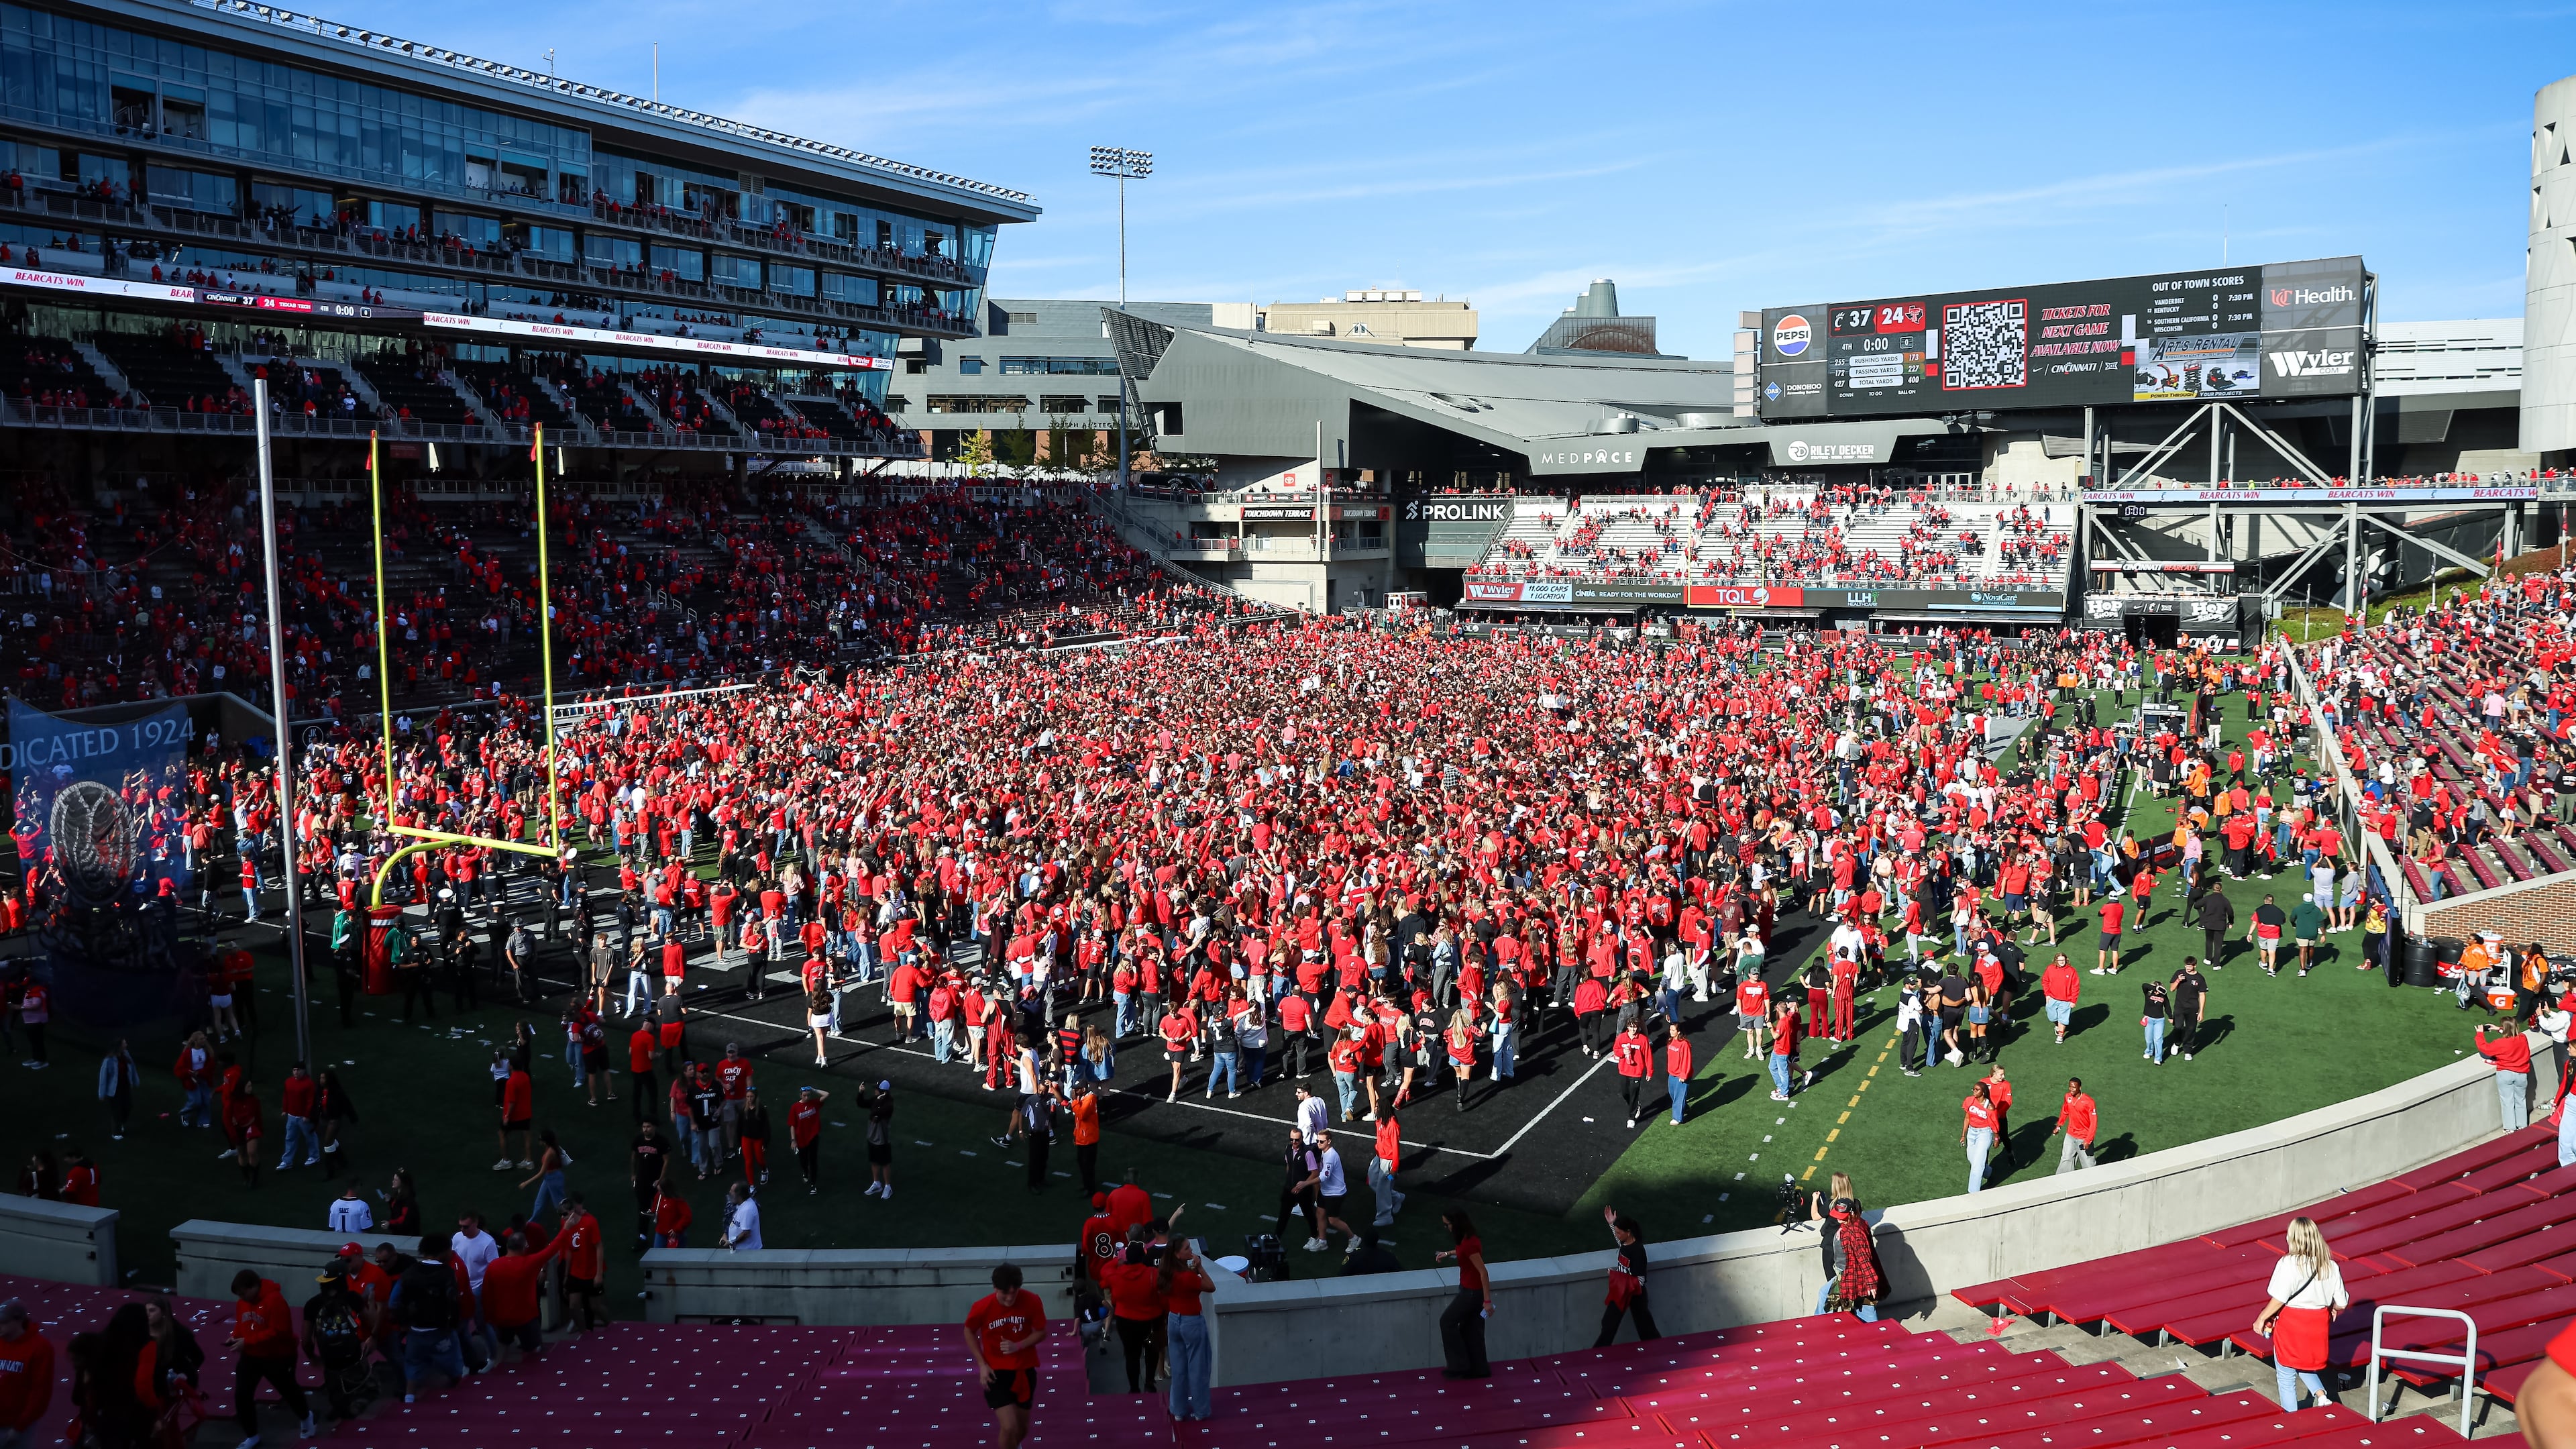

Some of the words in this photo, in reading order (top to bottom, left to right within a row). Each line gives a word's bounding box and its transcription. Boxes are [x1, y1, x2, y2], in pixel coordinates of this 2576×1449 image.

[15, 272, 64, 285] BEARCATS
[66, 278, 85, 287] WIN
[2152, 281, 2169, 292] OUT
[2171, 280, 2182, 290] OF
[2184, 278, 2210, 289] TOWN
[2212, 275, 2245, 287] SCORES
[207, 293, 237, 303] CINCINNATI
[242, 296, 254, 305] 37
[2154, 297, 2184, 306] VANDERBILT
[2228, 294, 2241, 302] 7:30
[2243, 292, 2253, 301] PM
[2270, 288, 2293, 307] UC
[264, 299, 275, 308] 24
[2212, 302, 2218, 310] 0
[335, 305, 354, 316] 0:00
[2041, 307, 2086, 321] TICKETS
[2086, 303, 2111, 317] FOR
[2153, 306, 2180, 314] KENTUCKY
[1849, 309, 1872, 327] 37
[1882, 307, 1903, 325] 24
[2153, 317, 2180, 325] SOUTHERN
[2180, 315, 2209, 323] CALIFORNIA
[2212, 313, 2218, 321] 0
[2228, 313, 2241, 321] 7:30
[458, 318, 470, 326] WIN
[2212, 321, 2218, 329] 0
[532, 325, 561, 335] BEARCATS
[562, 328, 574, 336] WIN
[2042, 324, 2074, 339] NEXT
[2074, 321, 2110, 335] GAME
[2153, 325, 2183, 333] WISCONSIN
[615, 333, 641, 343] BEARCATS
[1776, 330, 1809, 341] PEPSI
[697, 341, 720, 350] BEARCATS
[1842, 343, 1853, 351] 4TH
[1864, 337, 1888, 352] 0:00
[2030, 341, 2090, 357] AVAILABLE
[2090, 339, 2122, 354] NOW
[2152, 339, 2190, 361] ART'S
[2193, 337, 2236, 352] RENTAL
[766, 349, 788, 357] BEARCATS
[1909, 354, 1919, 362] 173
[2268, 348, 2355, 377] Wyler
[1835, 369, 1845, 377] 172
[1908, 364, 1919, 372] 227
[2051, 362, 2096, 374] CINCINNATI
[1834, 380, 1845, 388] 427
[1908, 376, 1919, 384] 400
[1786, 383, 1822, 391] DONOHOO
[1810, 445, 1837, 455] RILEY
[1839, 444, 1874, 455] DECKER
[1542, 448, 1632, 464] MEDPACE
[2082, 491, 2118, 500] EARCATS
[2199, 491, 2241, 500] BEARCATS
[2243, 491, 2261, 499] WIN
[2327, 490, 2375, 499] BEARCATS
[2377, 490, 2396, 498] WIN
[2473, 488, 2526, 498] BEARCATS
[1244, 508, 1283, 518] TOUCHDOWN
[1284, 509, 1312, 518] TERRACE
[1343, 509, 1363, 517] TOUCHDOWN
[1363, 509, 1377, 517] TERRACE
[1422, 504, 1506, 520] PROLINK
[2125, 506, 2145, 516] 0:00
[2123, 563, 2162, 572] CINCINNATI
[1487, 585, 1515, 594] Wyler
[1715, 588, 1751, 604] TQL
[1847, 592, 1872, 602] LLH
[1982, 592, 2018, 601] NovaCare
[2088, 600, 2123, 614] HOP
[2191, 601, 2229, 617] HOP
[2094, 611, 2118, 619] SHOPS
[2198, 613, 2224, 621] SHOPS
[131, 716, 197, 749] 1924
[561, 782, 570, 790] 45
[1091, 947, 1097, 956] 2
[2485, 943, 2498, 952] G
[2493, 996, 2506, 1007] G
[724, 1065, 741, 1076] CINCY
[703, 1099, 709, 1116] 1
[1095, 1232, 1114, 1258] 8
